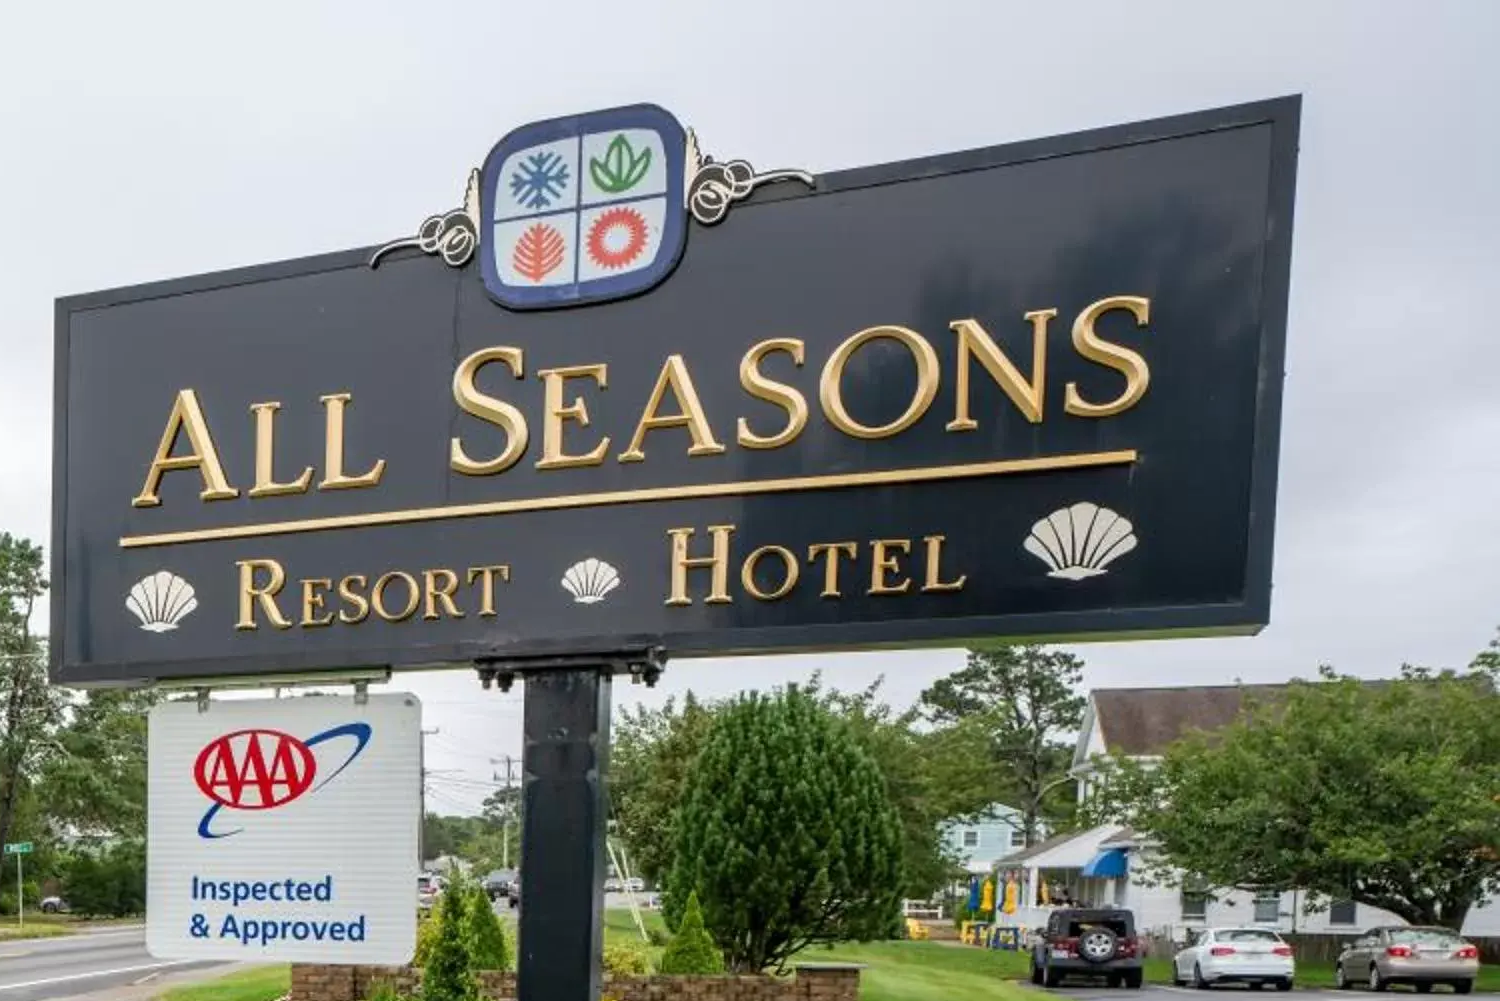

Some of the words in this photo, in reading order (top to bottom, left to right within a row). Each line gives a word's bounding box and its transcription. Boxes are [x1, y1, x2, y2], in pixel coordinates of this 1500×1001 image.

[130, 387, 386, 506] ALL
[451, 296, 1150, 476] SEASONS
[235, 558, 512, 631] RESORT
[666, 522, 967, 605] HOTEL
[210, 733, 301, 805] AAA
[192, 875, 332, 905] Inspected
[190, 914, 210, 939] &
[220, 915, 365, 945] Approved
